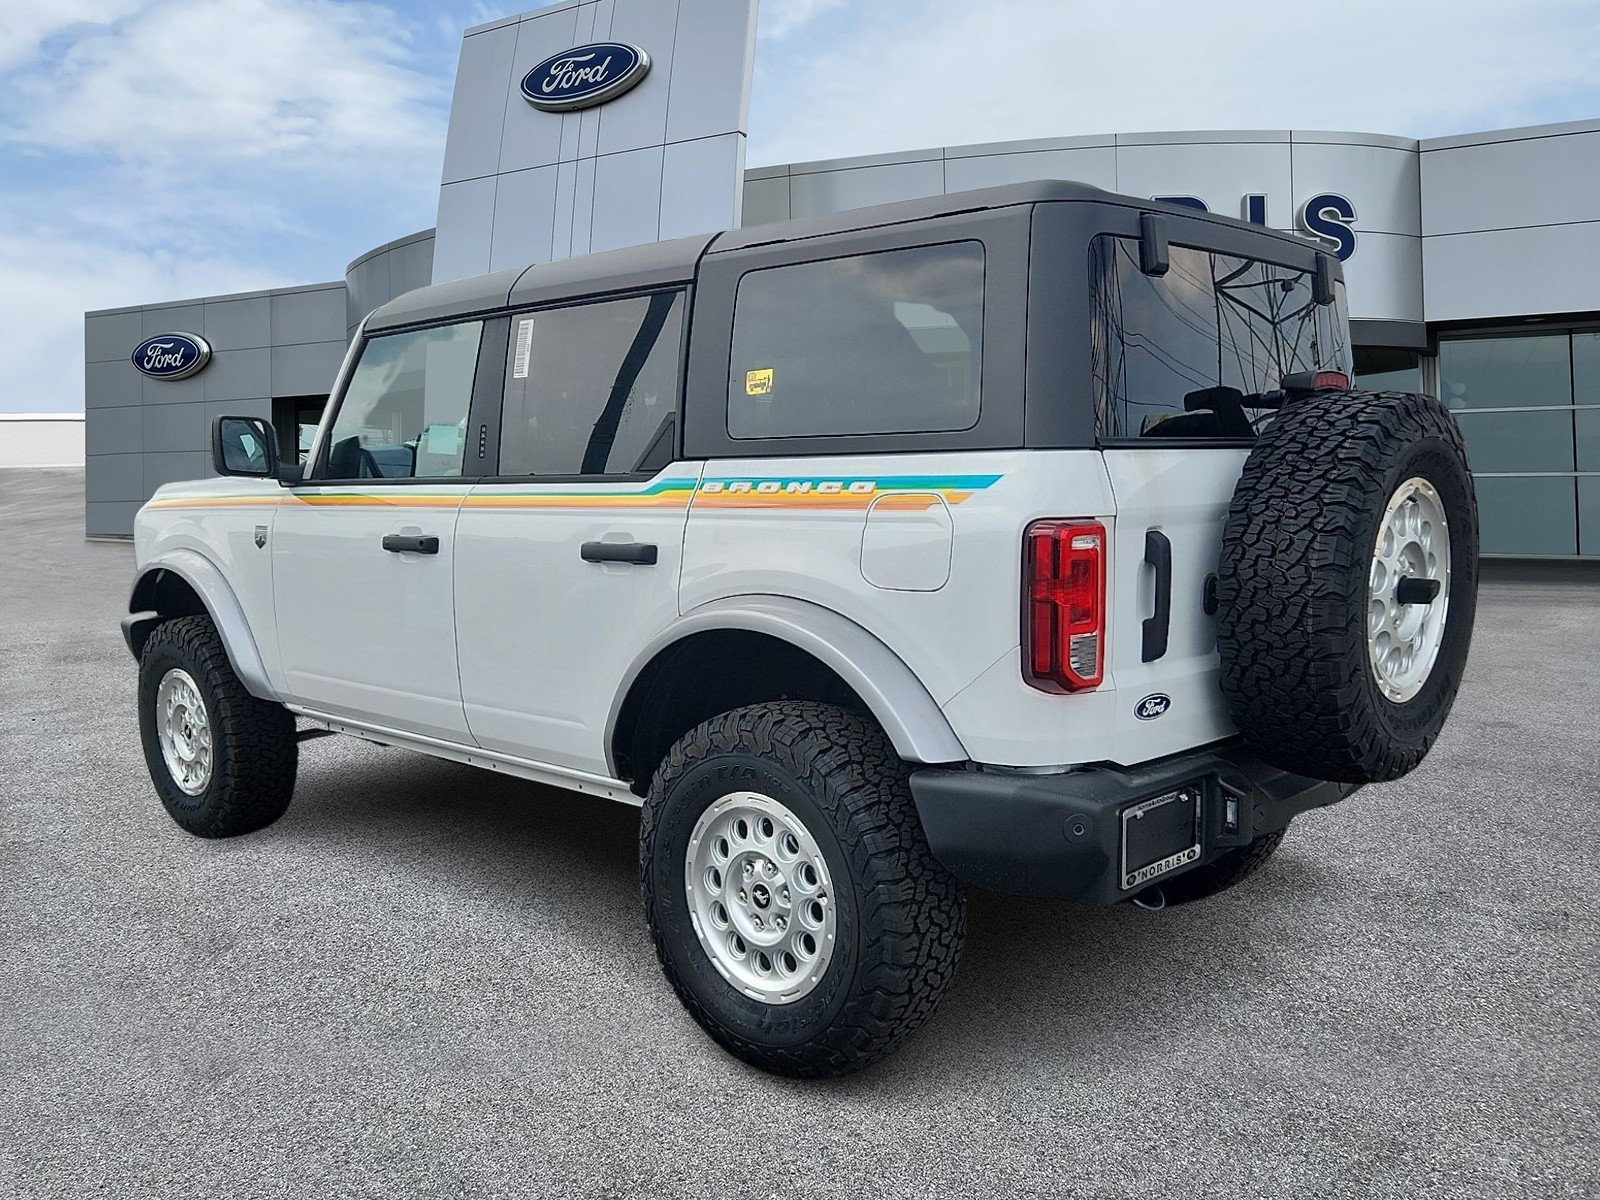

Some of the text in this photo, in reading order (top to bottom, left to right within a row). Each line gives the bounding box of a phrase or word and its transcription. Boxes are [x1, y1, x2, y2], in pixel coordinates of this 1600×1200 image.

[542, 53, 612, 93] Ford
[144, 342, 184, 369] Ford
[701, 481, 877, 494] BRONCO
[1142, 698, 1166, 716] Ford
